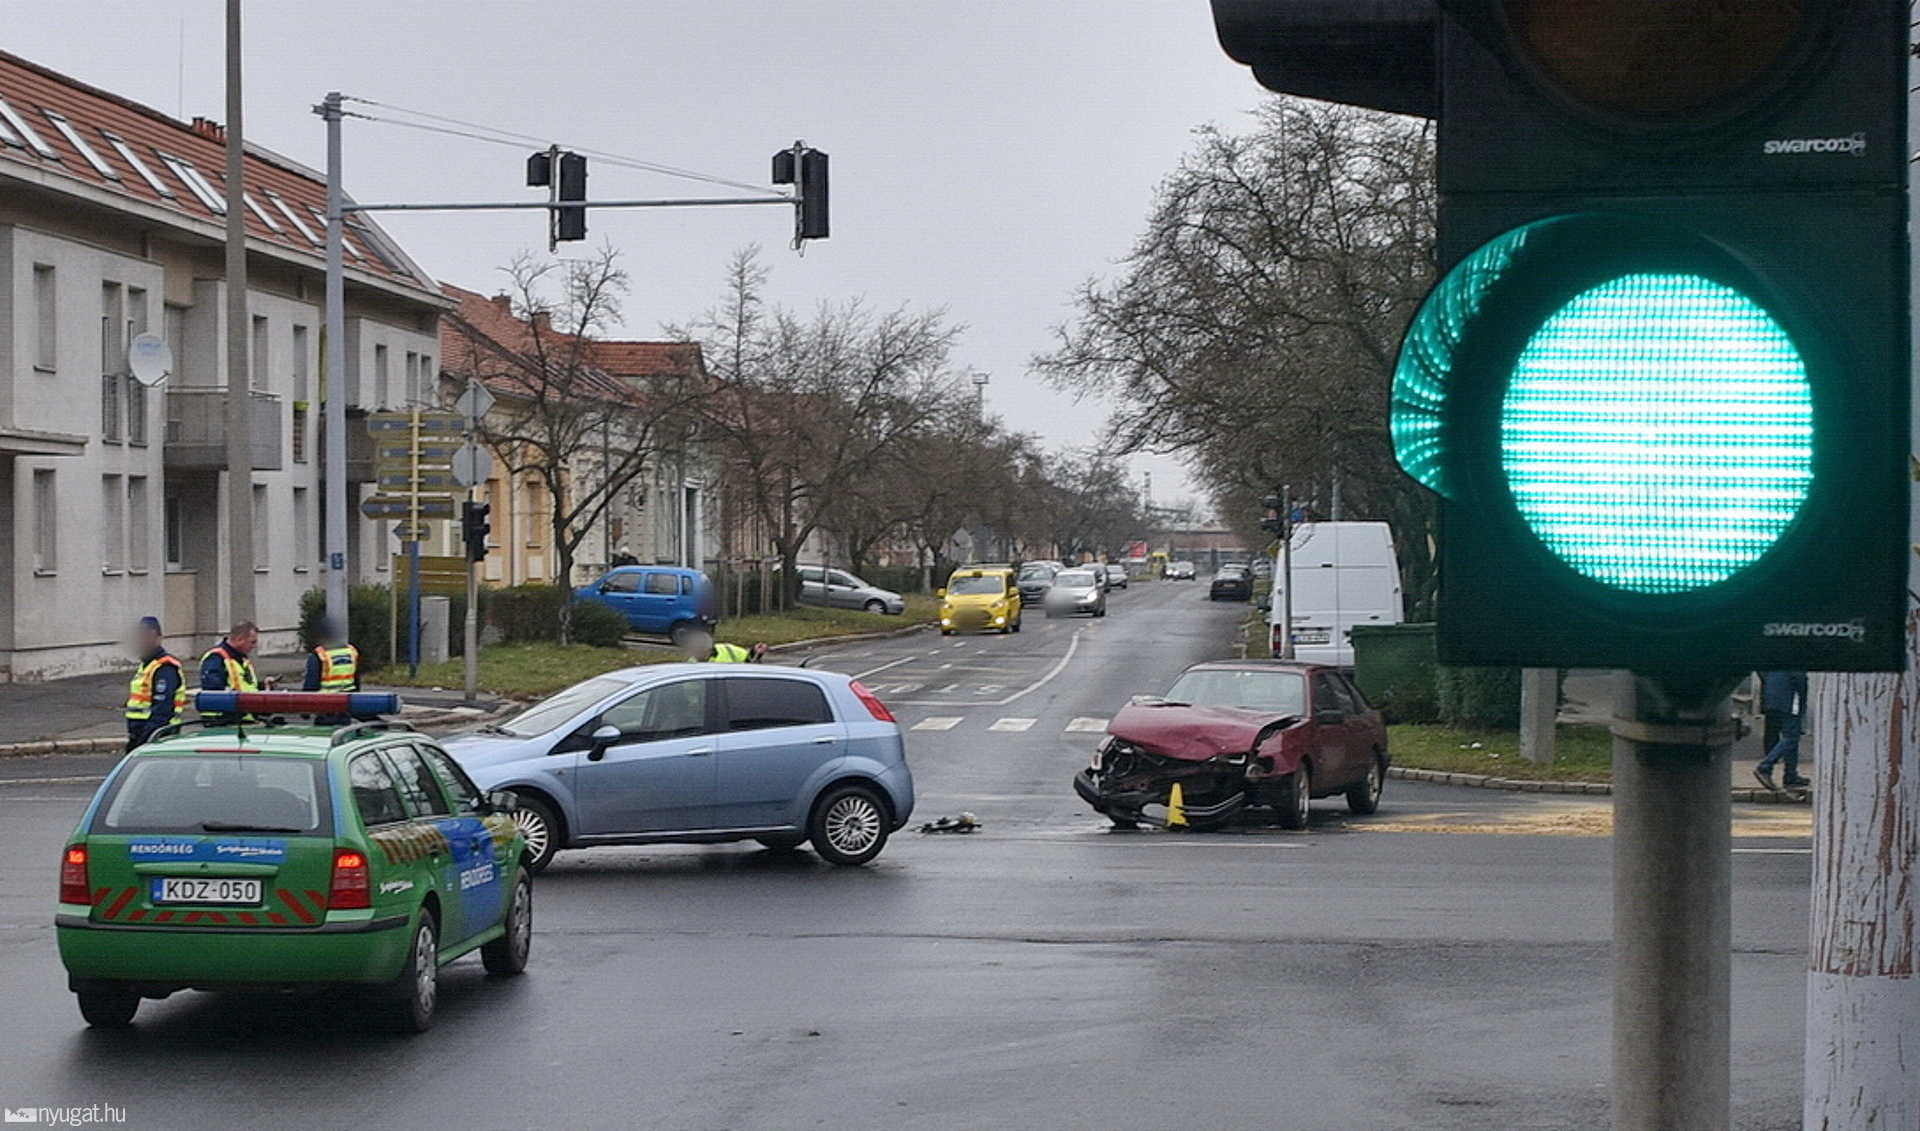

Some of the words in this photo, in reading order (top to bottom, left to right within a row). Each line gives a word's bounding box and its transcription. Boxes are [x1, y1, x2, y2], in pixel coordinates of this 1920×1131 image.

[1763, 138, 1838, 154] swarco
[1763, 622, 1838, 637] swarco
[166, 881, 256, 900] KDZ-050
